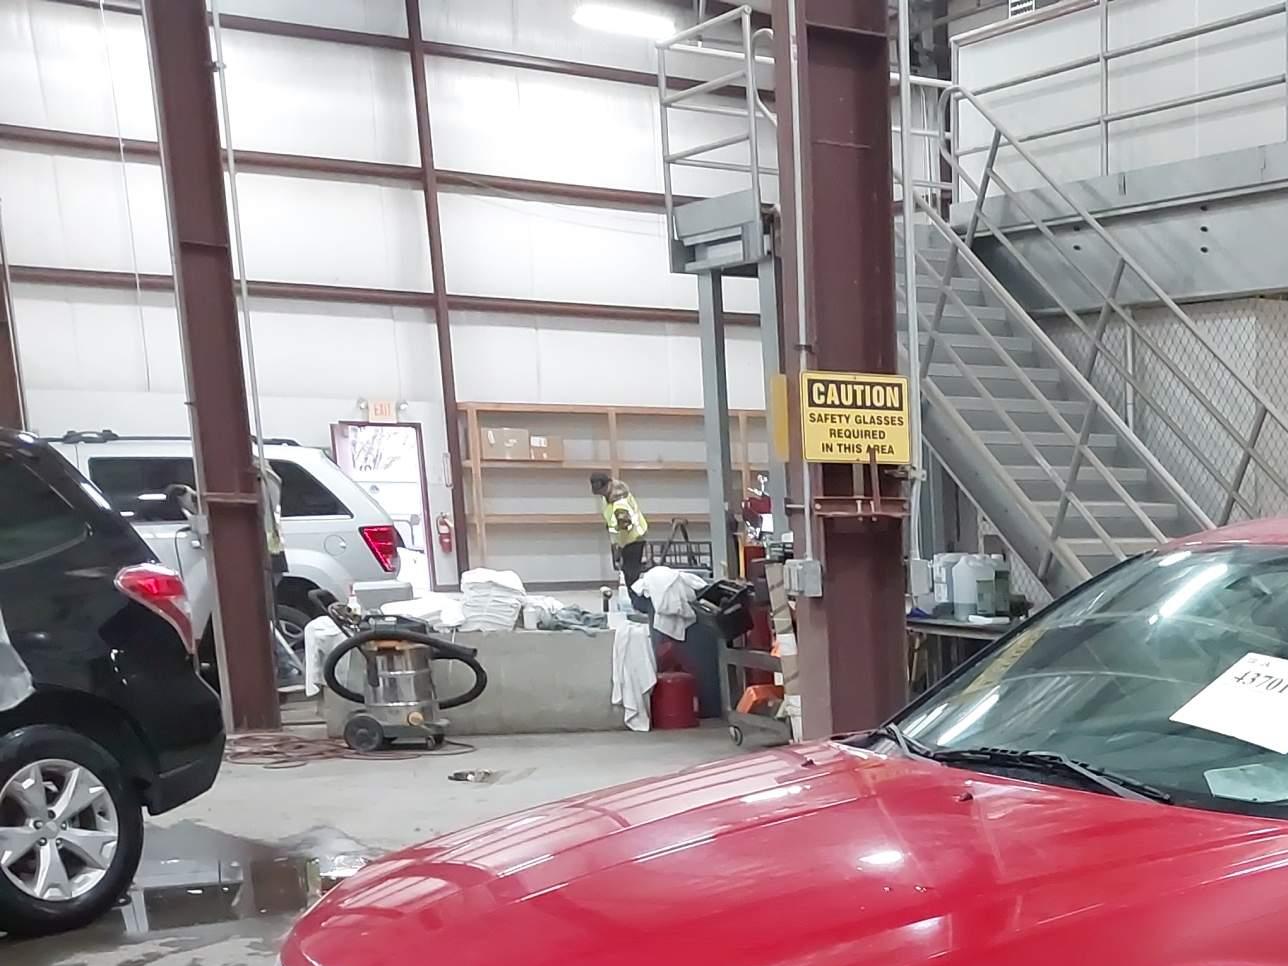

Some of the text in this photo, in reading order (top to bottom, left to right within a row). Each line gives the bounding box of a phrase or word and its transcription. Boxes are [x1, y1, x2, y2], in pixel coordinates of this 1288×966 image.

[812, 382, 900, 408] CAUTION
[809, 412, 904, 426] SAFETY GLASSES
[829, 428, 886, 440] REQUIRED
[822, 443, 895, 455] IN THIS AREA
